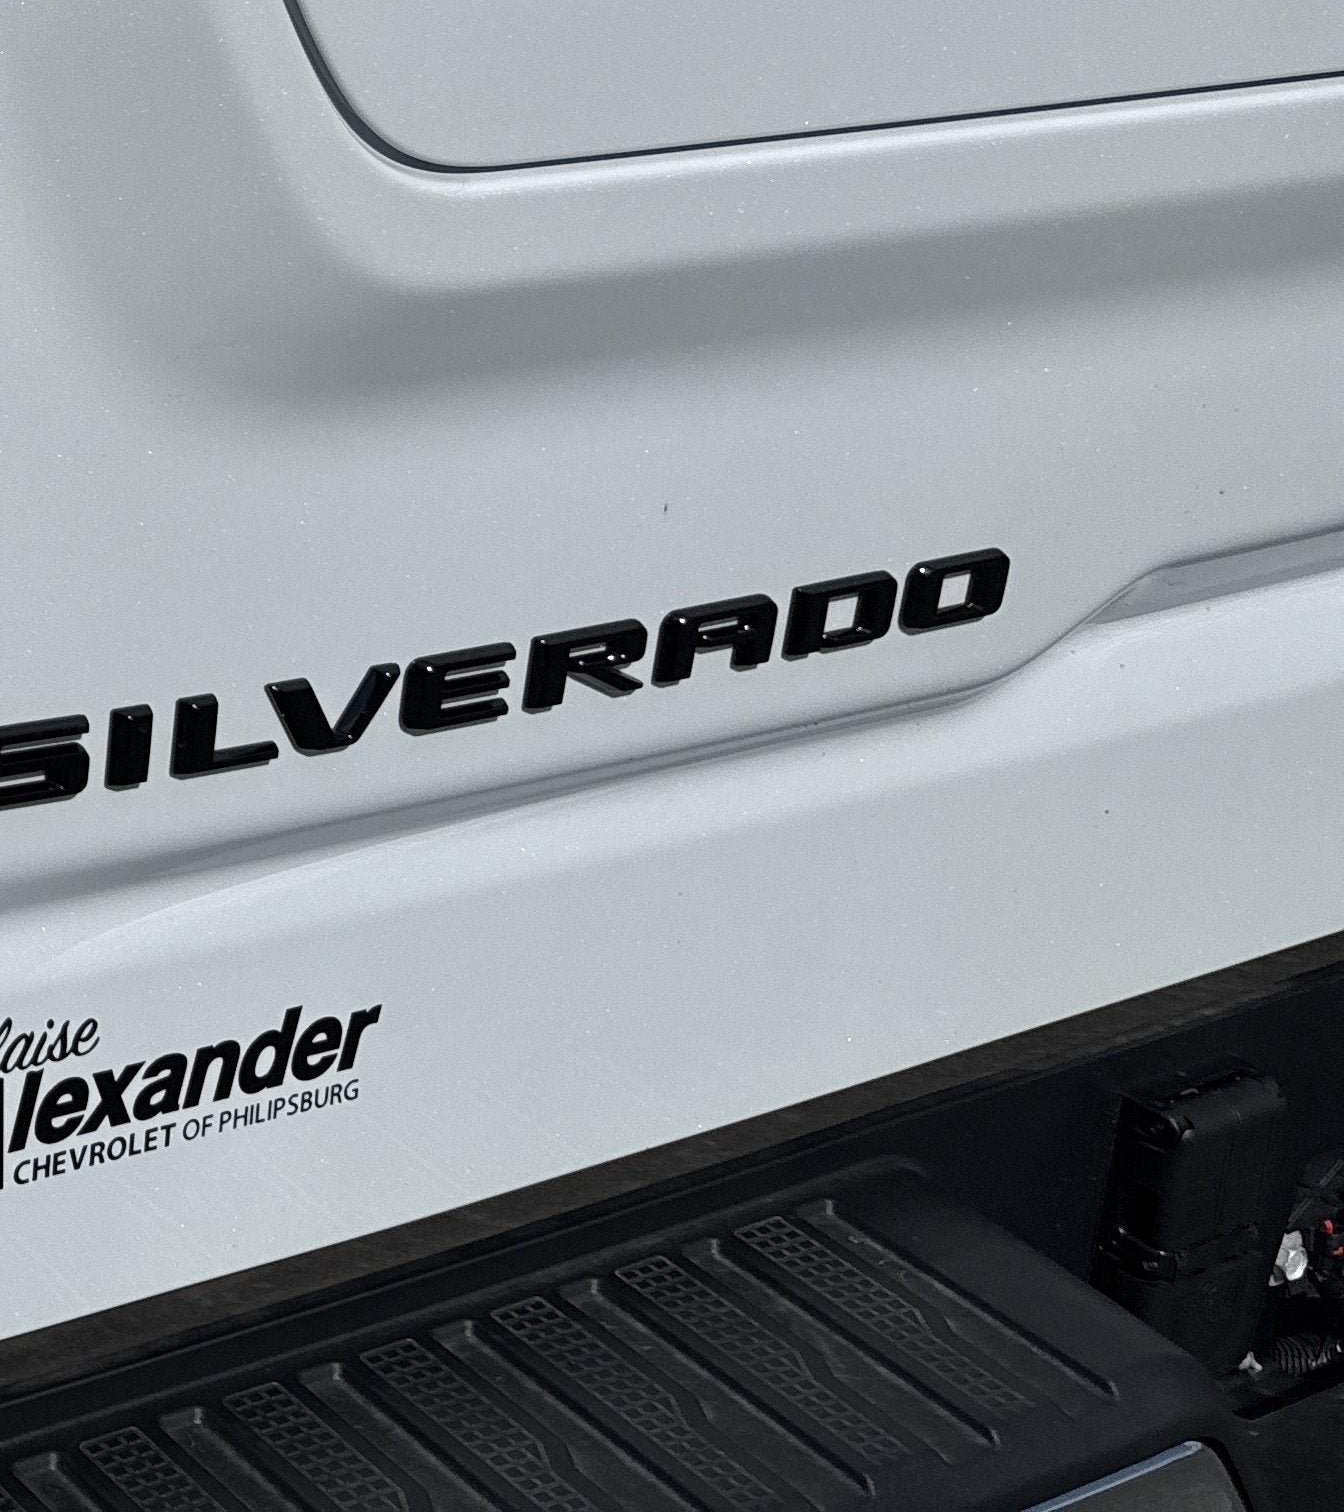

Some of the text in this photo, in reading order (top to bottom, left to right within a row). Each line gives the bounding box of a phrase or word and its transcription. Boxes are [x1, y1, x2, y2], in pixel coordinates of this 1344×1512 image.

[13, 1078, 360, 1185] CHEVROLET OF PHILIPSBURG
